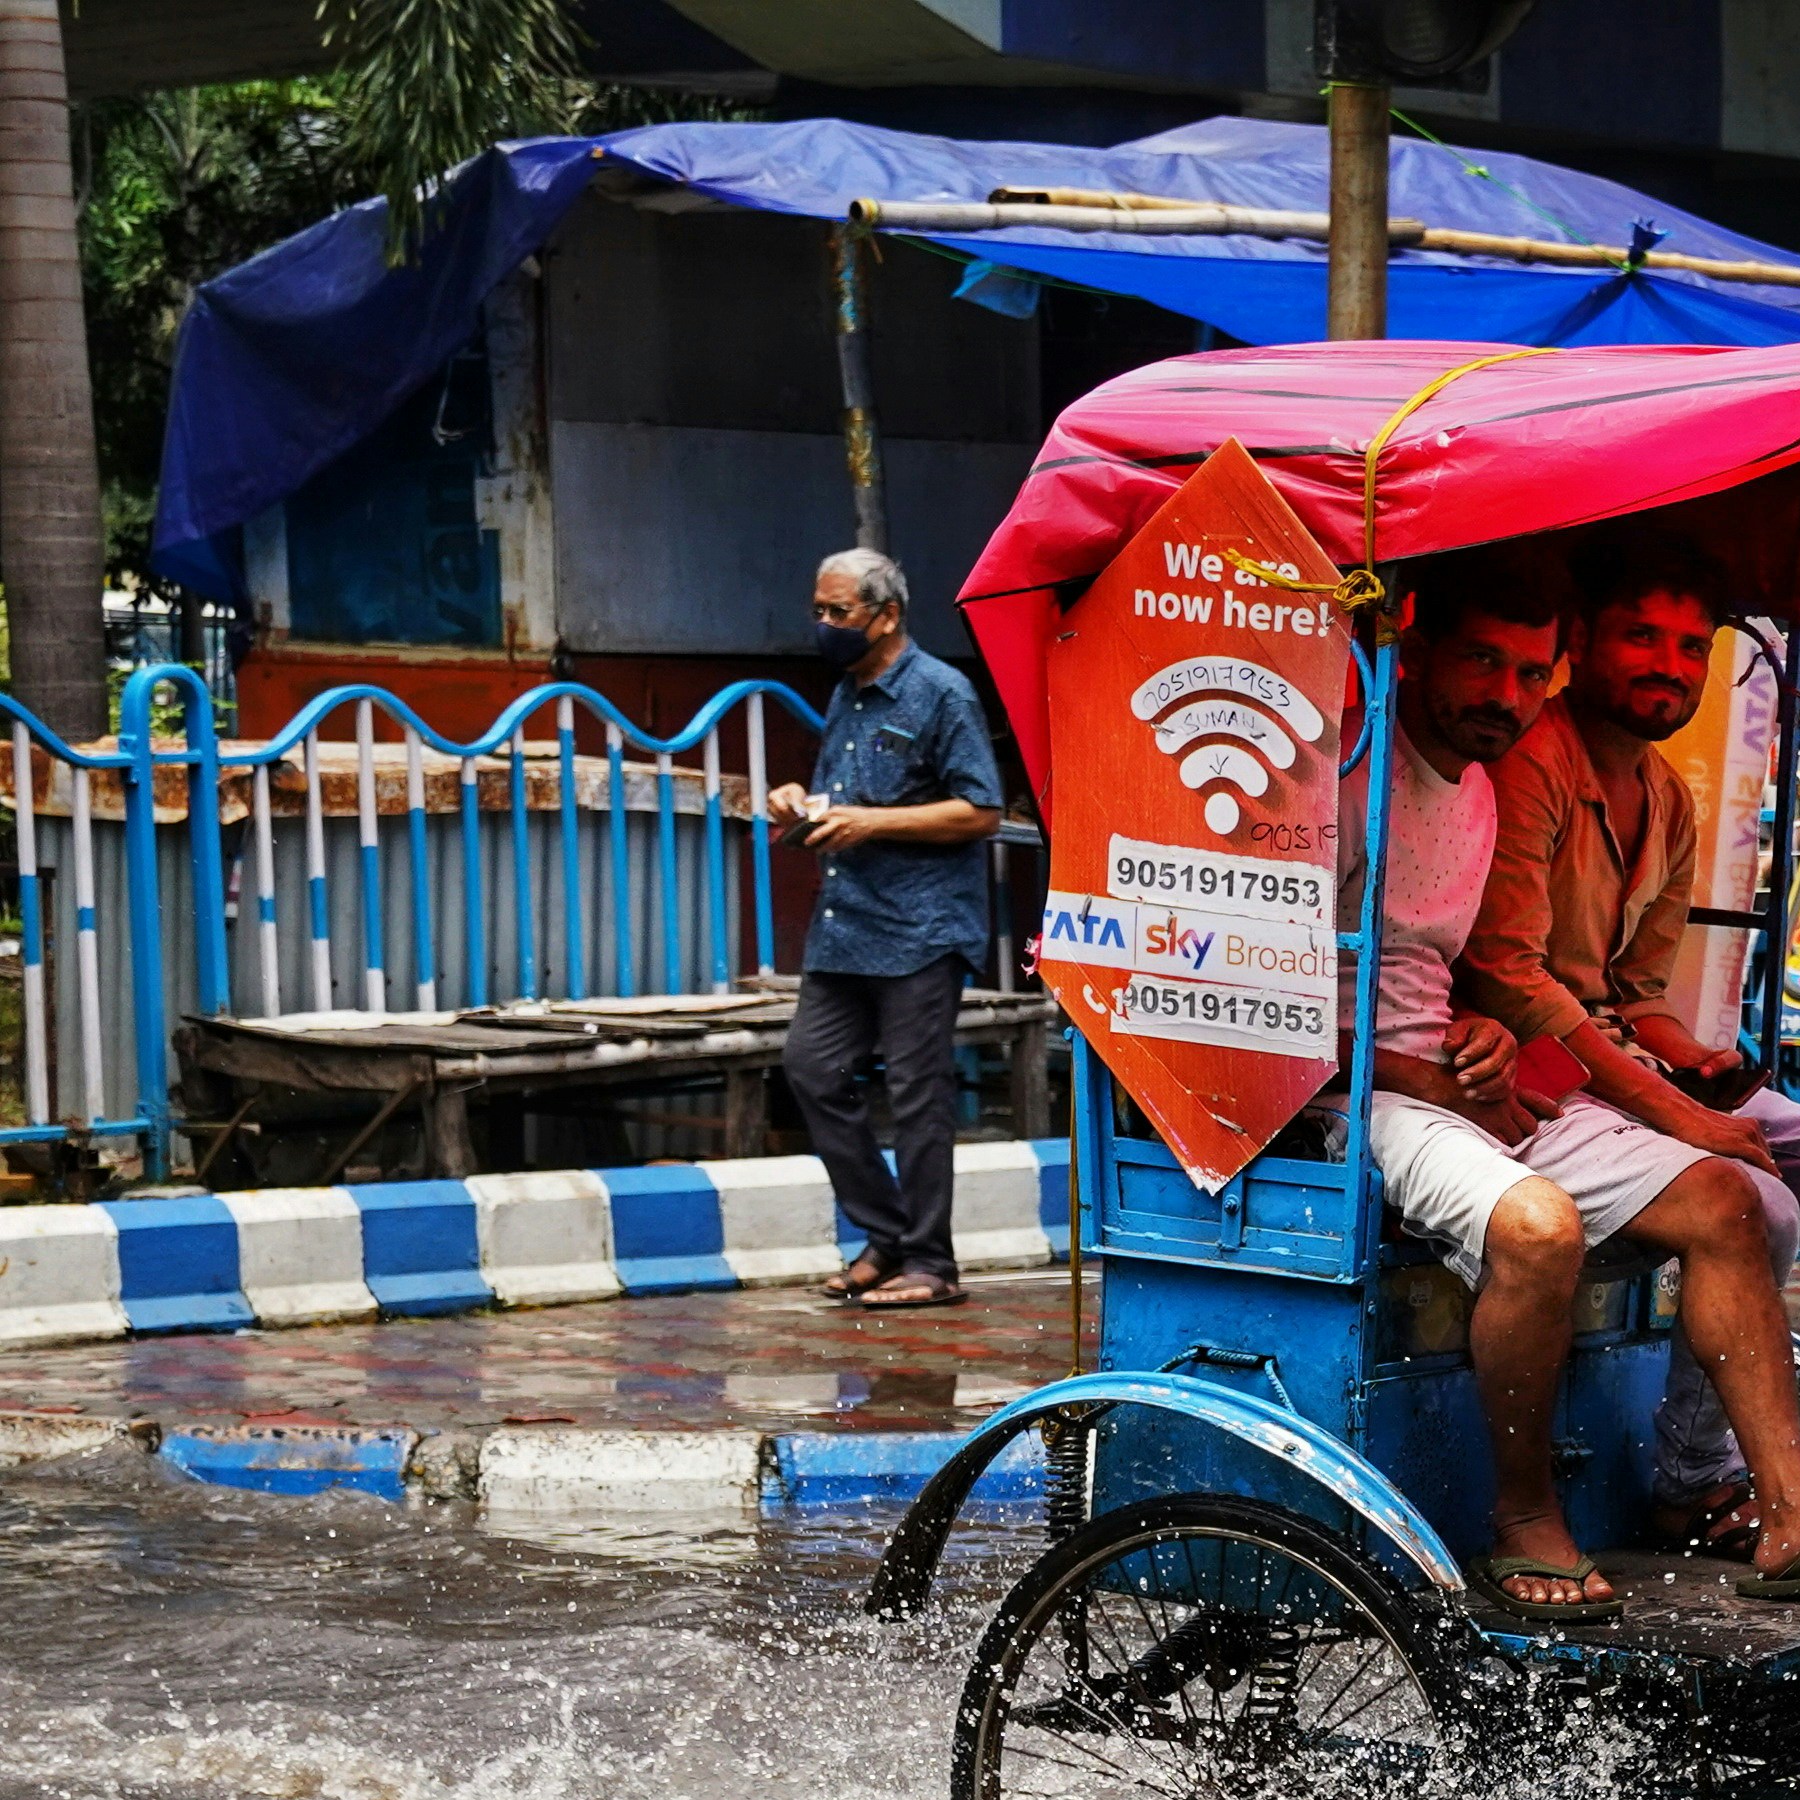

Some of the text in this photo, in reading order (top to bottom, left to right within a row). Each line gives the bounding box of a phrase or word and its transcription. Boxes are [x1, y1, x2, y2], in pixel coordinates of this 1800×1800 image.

[1163, 541, 1224, 583] We
[1134, 588, 1329, 638] now here!
[1183, 709, 1256, 737] SUMAN
[1116, 856, 1321, 908] 9051917953
[1145, 916, 1216, 970] sky
[1122, 985, 1324, 1035] 9051917953
